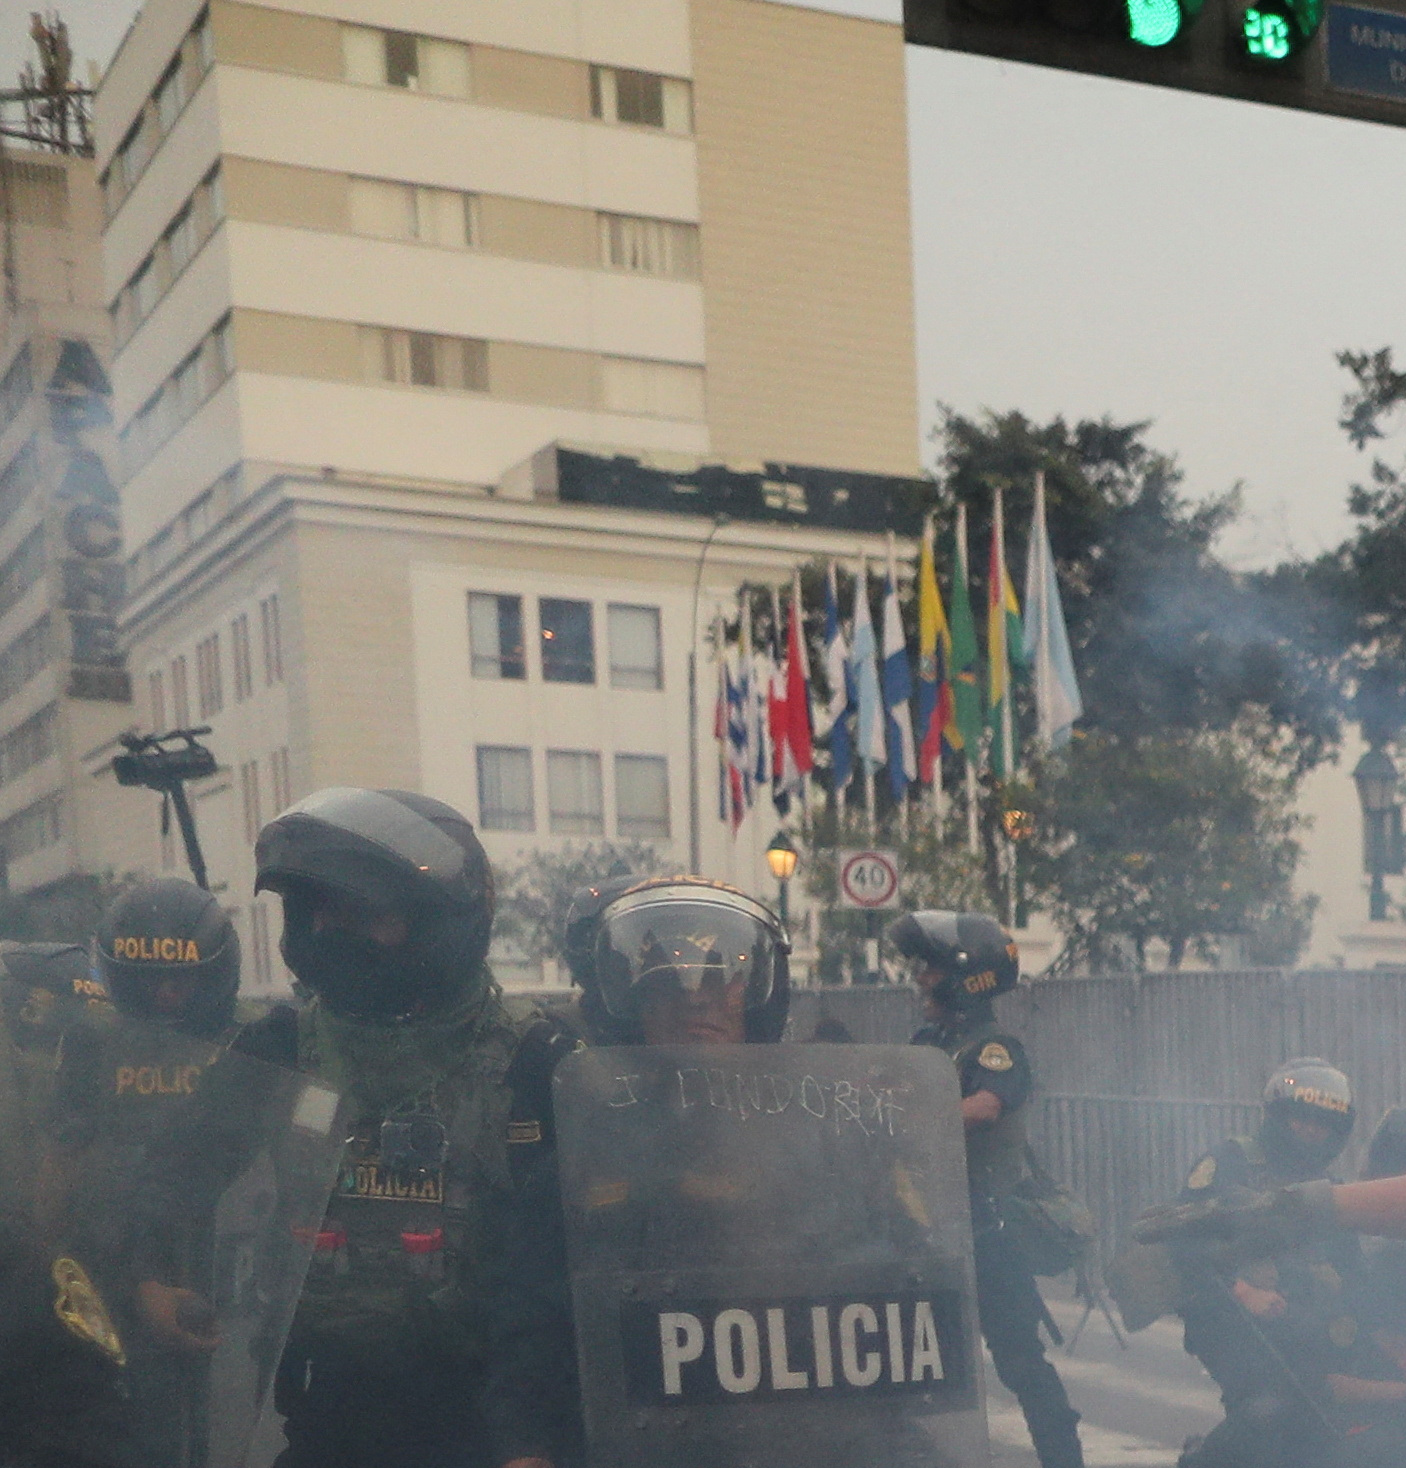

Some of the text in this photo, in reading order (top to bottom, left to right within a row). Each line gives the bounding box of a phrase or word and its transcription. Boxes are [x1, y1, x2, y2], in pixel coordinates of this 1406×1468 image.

[855, 866, 885, 887] 40
[113, 937, 200, 962] POLICIA
[964, 970, 997, 993] GIR
[342, 1165, 437, 1200] OLICIA
[658, 1301, 945, 1396] POLICIA
